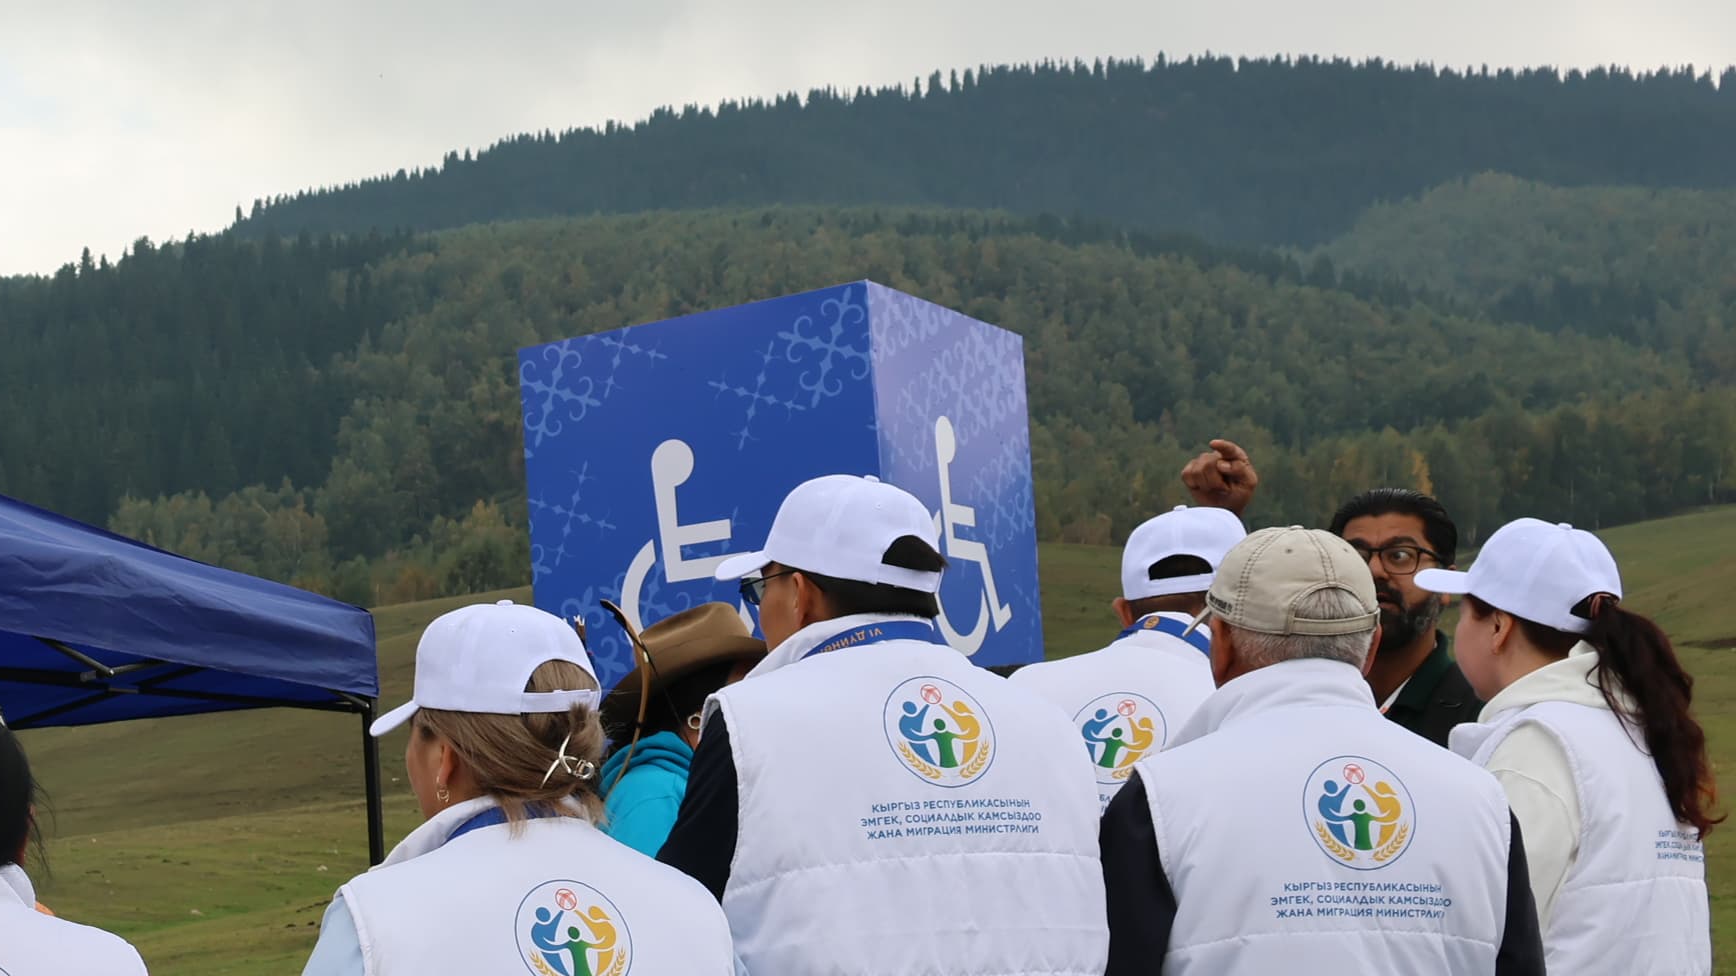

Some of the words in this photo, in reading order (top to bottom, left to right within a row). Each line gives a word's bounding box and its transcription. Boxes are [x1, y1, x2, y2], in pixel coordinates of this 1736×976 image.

[872, 802, 920, 813] КЫРГЫЗ
[924, 799, 1030, 809] РЕСПУБЛИКАСЫНЫН
[861, 816, 902, 827] ЭМГЕК,
[905, 812, 974, 824] СОЦИАЛДЫК
[978, 812, 1041, 821] КАМСЫЗДОО
[867, 830, 902, 839] ЖАНА
[906, 826, 961, 836] МИГРАЦИЯ
[966, 825, 1039, 834] МИНИСТРЛИГИ
[1284, 882, 1332, 892] КЫРГЫЗ
[1271, 896, 1313, 905] ЭМГЕК,
[1317, 895, 1385, 905] СОЦИАЛДЫК
[1277, 909, 1312, 918] ЖАНА
[1317, 908, 1372, 918] МИГРАЦИЯ
